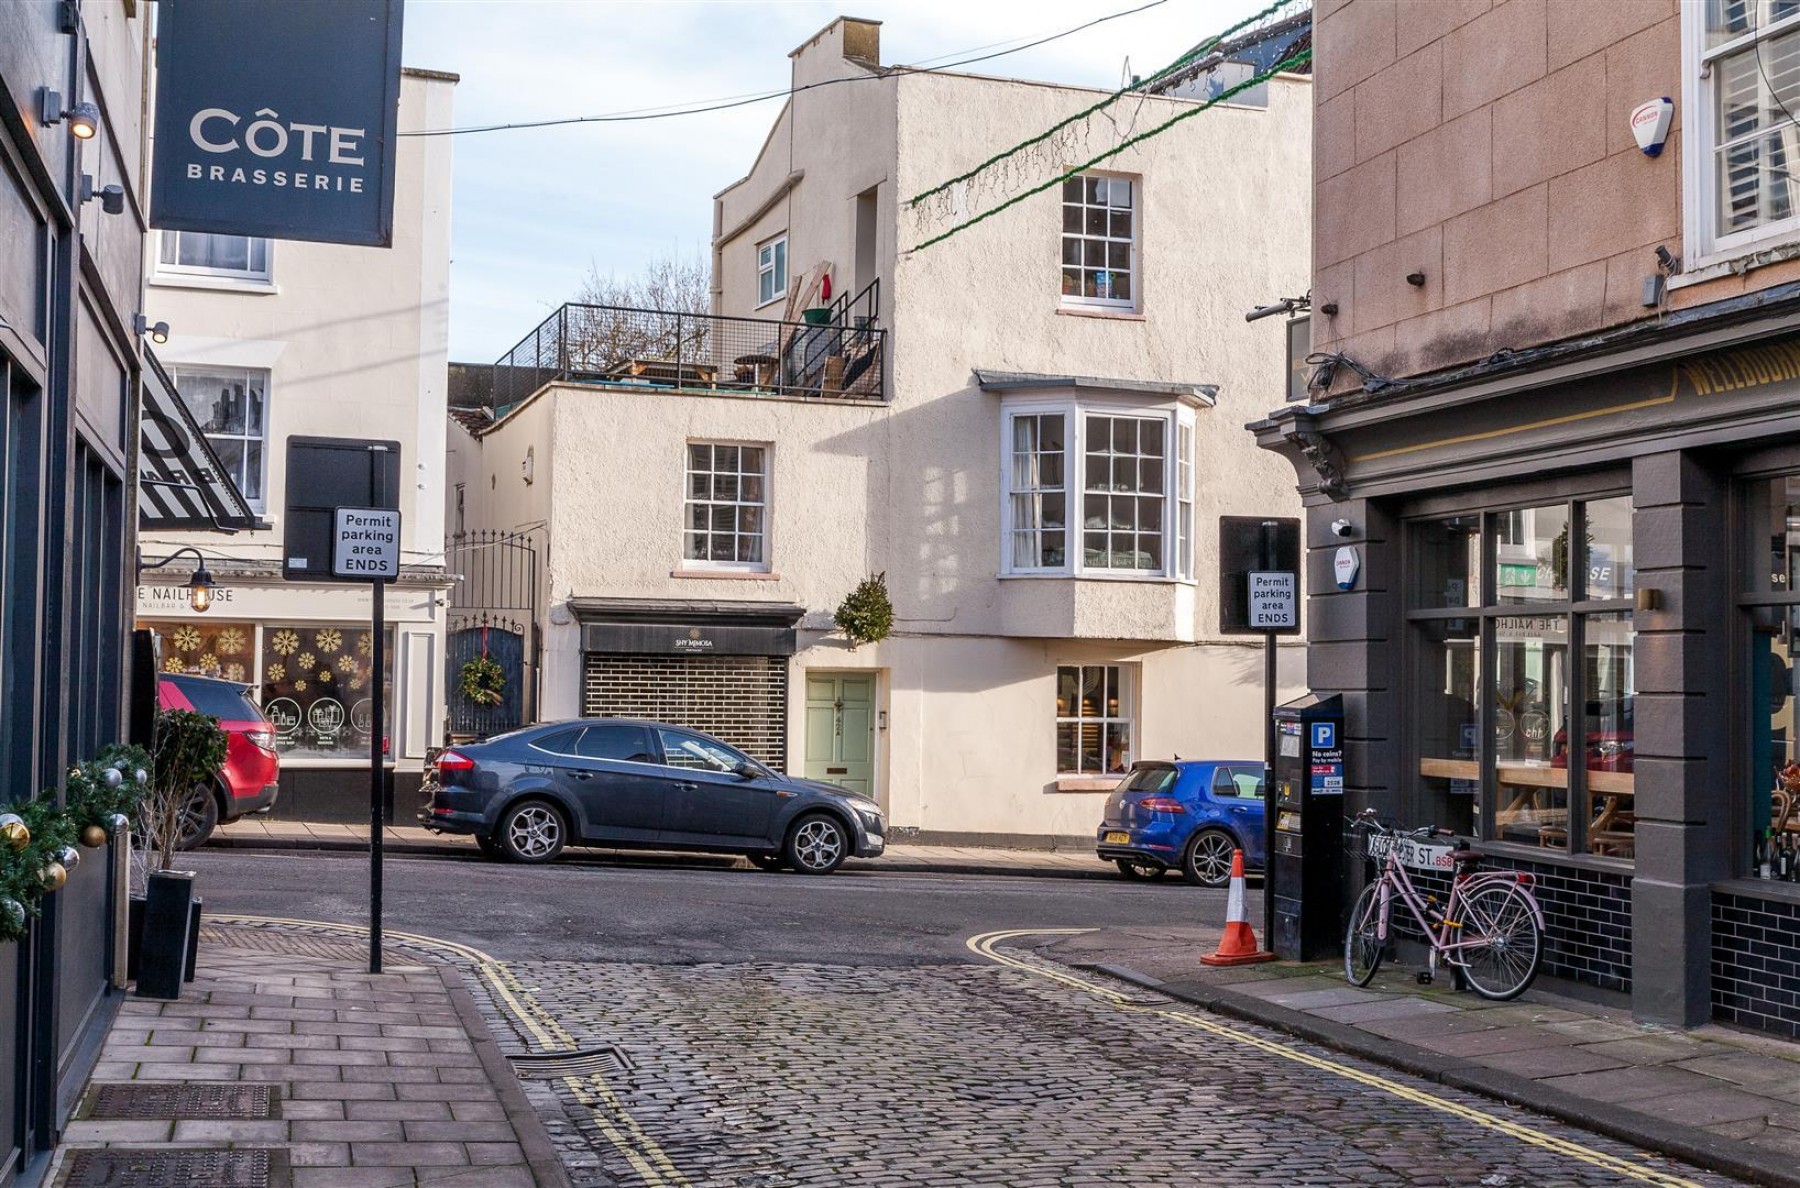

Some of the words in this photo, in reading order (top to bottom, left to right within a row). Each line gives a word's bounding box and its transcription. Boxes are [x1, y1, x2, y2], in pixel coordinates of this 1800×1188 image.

[189, 107, 365, 166] CÔTE
[187, 163, 364, 193] BRASSERIE
[346, 514, 392, 527] Permit
[341, 530, 394, 544] parking
[352, 545, 382, 555] area
[345, 559, 388, 571] ENDS
[1256, 577, 1289, 586] Permit
[153, 588, 233, 602] NAILHUSE
[1254, 589, 1291, 600] parking
[1262, 602, 1284, 610] area
[1258, 613, 1288, 623] ENDS
[1318, 726, 1331, 744] P
